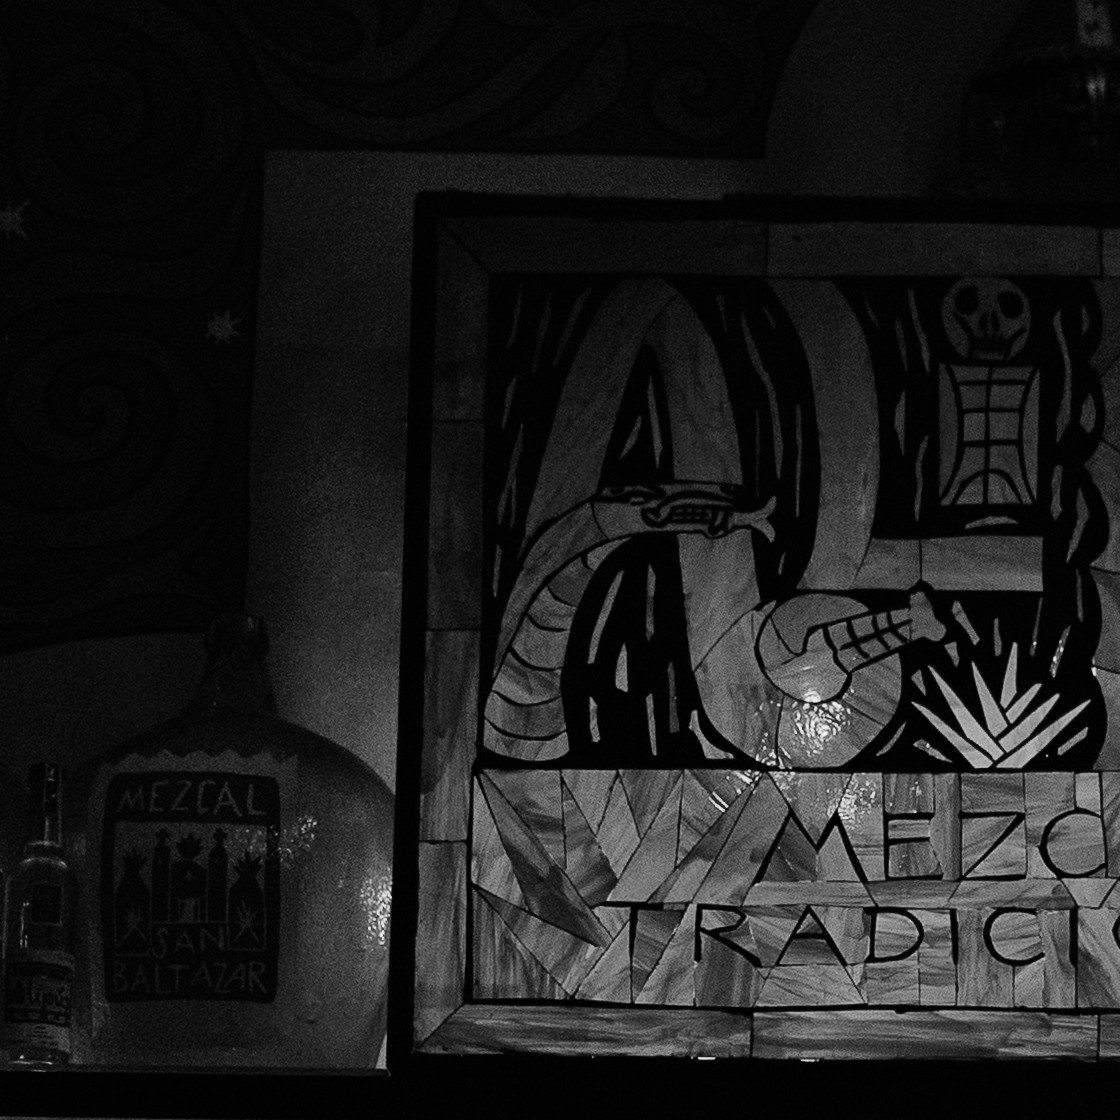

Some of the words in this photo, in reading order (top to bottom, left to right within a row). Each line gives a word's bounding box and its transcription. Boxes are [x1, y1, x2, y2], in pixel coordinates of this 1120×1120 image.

[116, 779, 267, 817] MEZCAL
[150, 925, 227, 959] SAN
[112, 961, 267, 995] BALTAZAR
